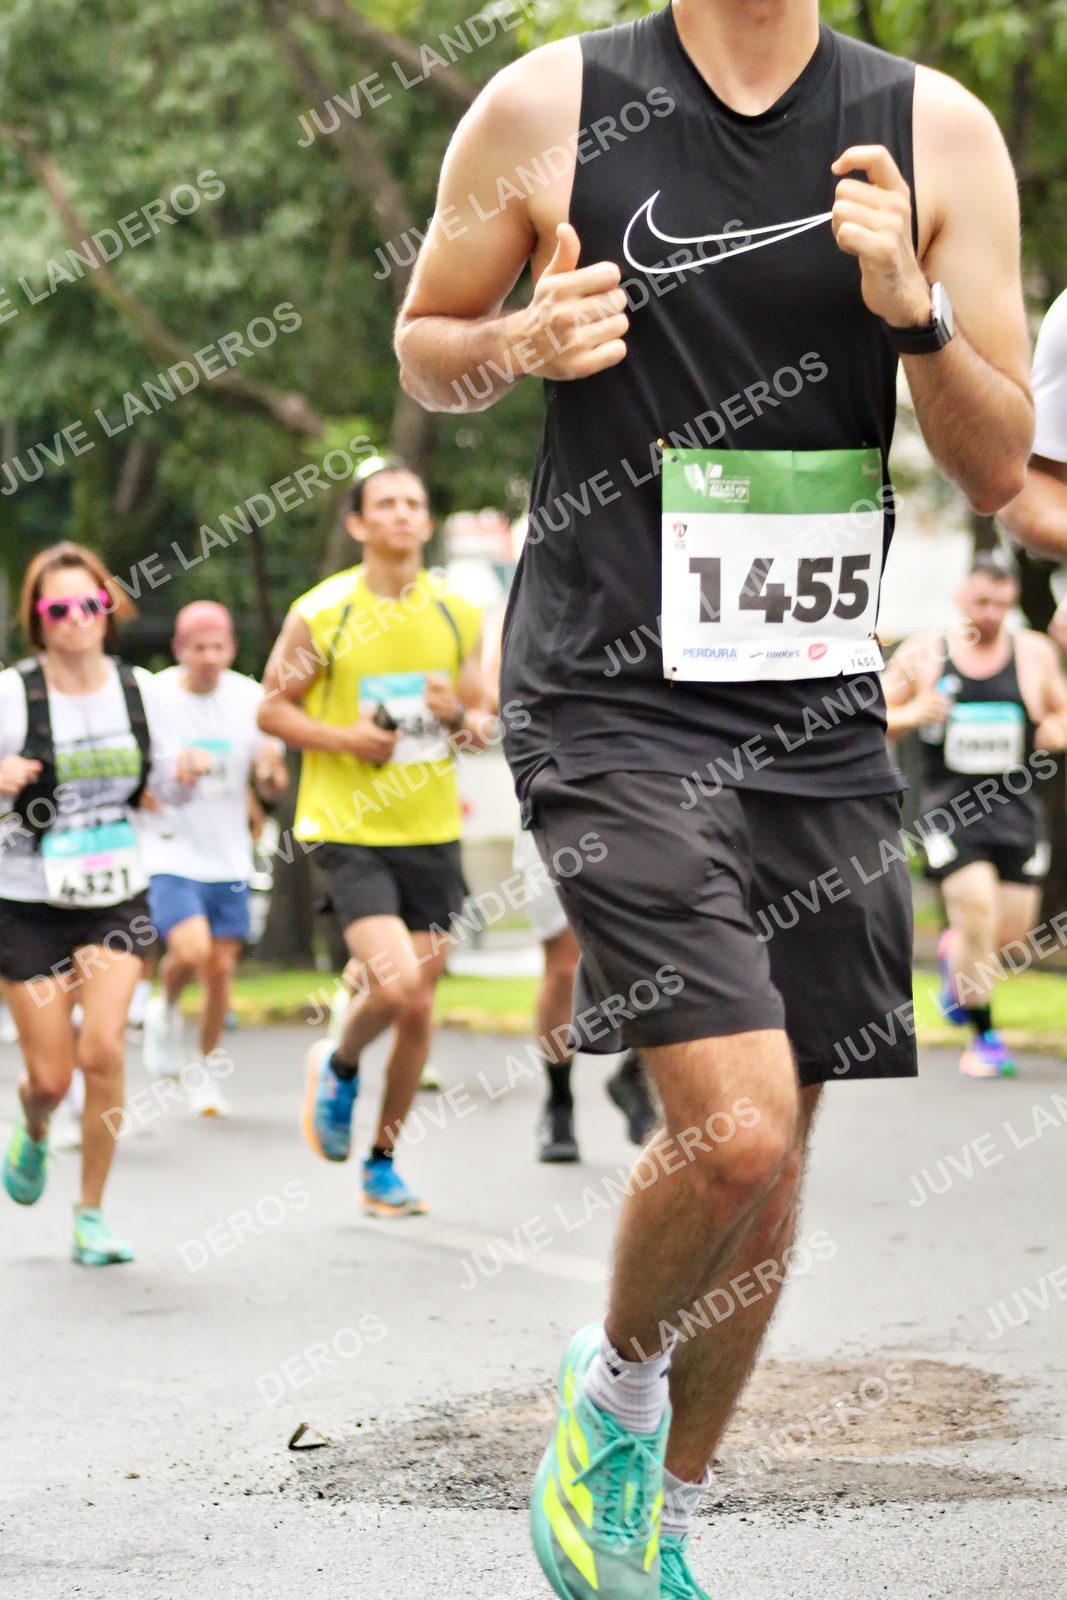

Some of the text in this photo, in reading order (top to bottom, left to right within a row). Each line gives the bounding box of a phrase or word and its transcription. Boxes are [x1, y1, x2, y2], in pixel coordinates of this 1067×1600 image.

[688, 554, 871, 623] 1455
[683, 648, 737, 659] PERDURA
[61, 868, 130, 897] 4321
